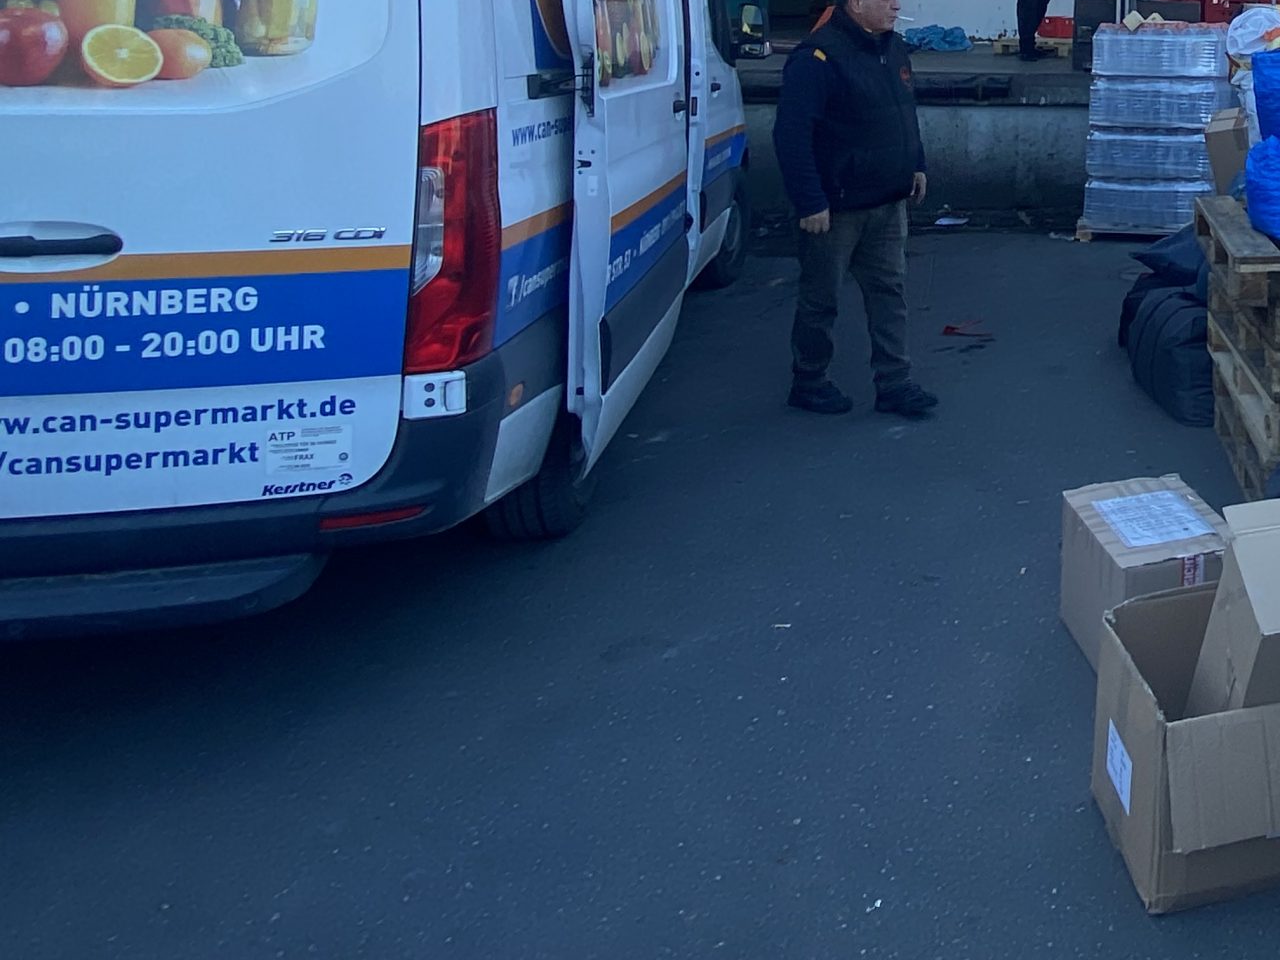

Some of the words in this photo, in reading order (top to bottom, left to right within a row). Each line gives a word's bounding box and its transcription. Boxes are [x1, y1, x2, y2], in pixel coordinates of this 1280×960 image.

[269, 229, 328, 243] 316
[333, 227, 387, 241] CDI
[51, 285, 259, 319] NÜRNBERG
[4, 335, 105, 364] 08:00
[115, 345, 131, 353] -
[141, 330, 240, 358] 20:00
[250, 324, 326, 352] UHR
[0, 395, 357, 435] w.can-supermarkt.de
[268, 431, 296, 442] ATP
[262, 480, 336, 496] Kerstner
